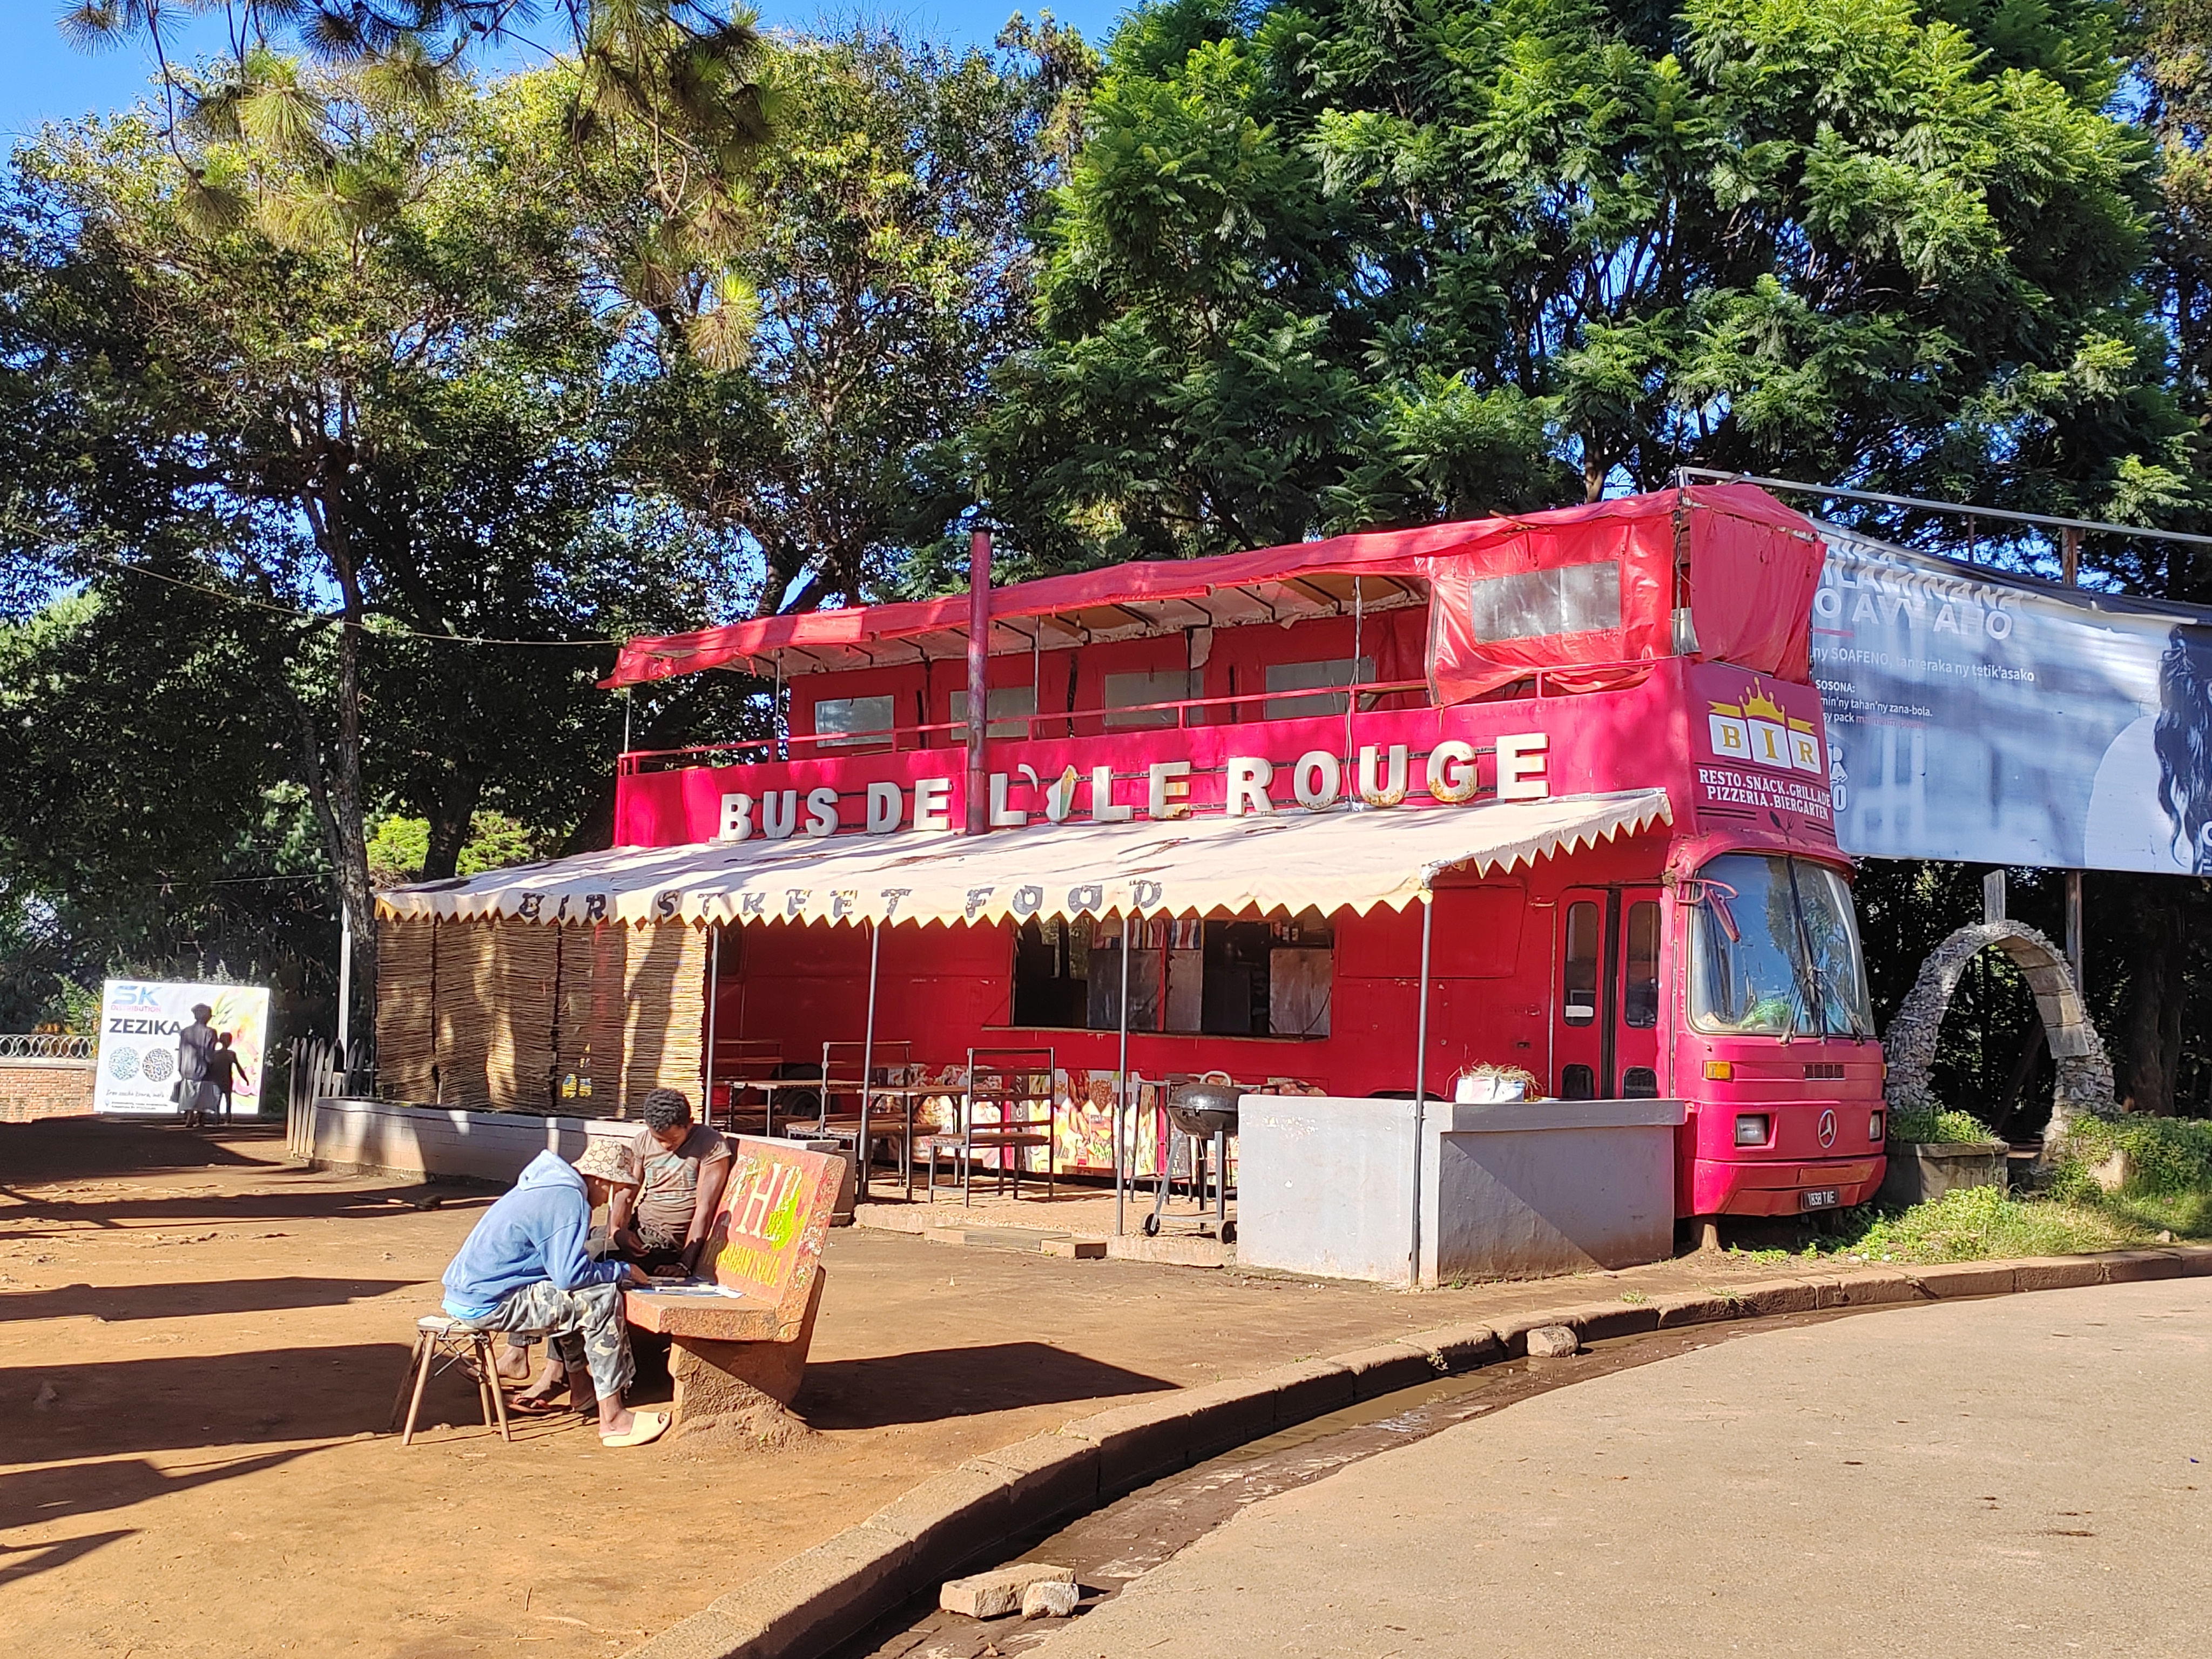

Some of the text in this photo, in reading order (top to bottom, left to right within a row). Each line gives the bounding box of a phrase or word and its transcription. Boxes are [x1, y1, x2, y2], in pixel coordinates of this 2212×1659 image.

[1852, 593, 1926, 628] AVY
[1933, 604, 2012, 639] AHO
[1955, 664, 1970, 677] ny
[1833, 712, 1854, 723] pack
[1851, 699, 1889, 713] tahan'ny
[1889, 703, 1933, 717] zana-bola.
[1720, 724, 1816, 765] BIR
[719, 787, 838, 842] BUS
[867, 778, 952, 834] DE
[1226, 733, 1550, 816] ROUGE
[965, 880, 1163, 918] FOOD
[111, 985, 162, 1006] SK
[109, 1018, 181, 1036] ZEZIKA
